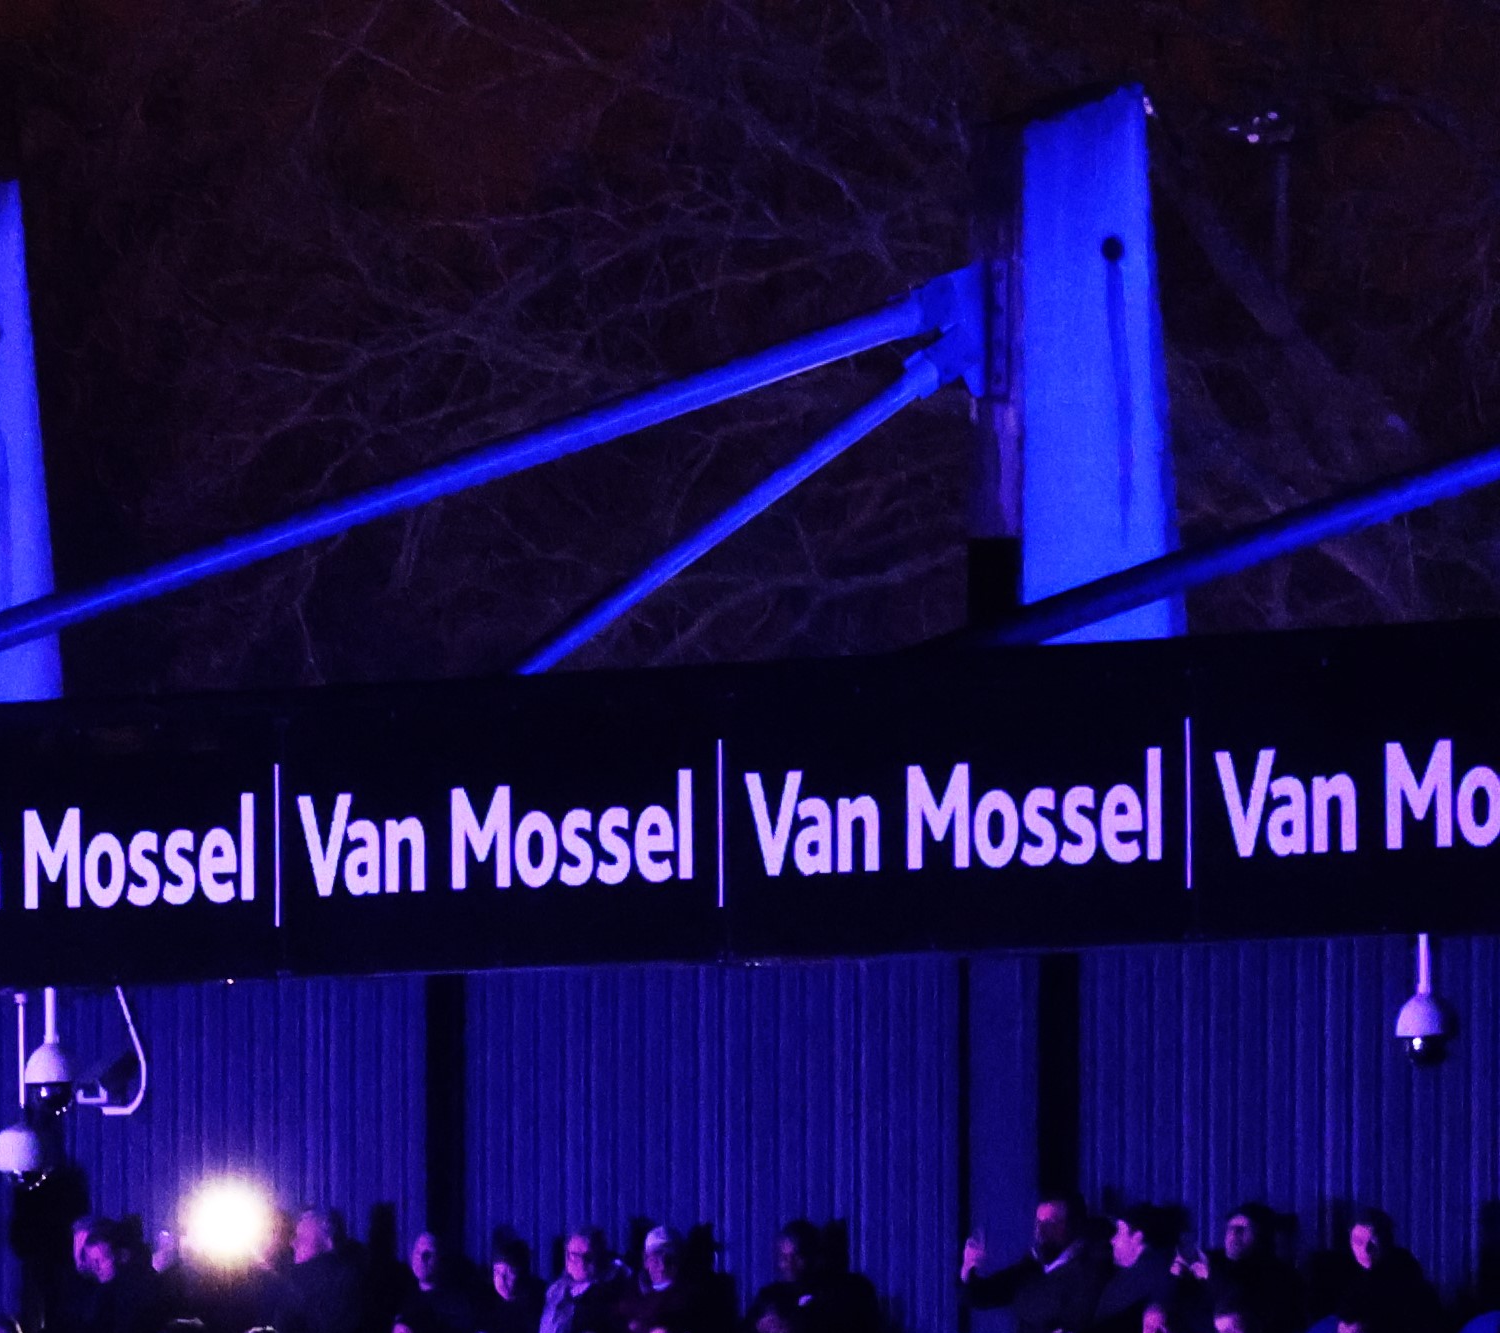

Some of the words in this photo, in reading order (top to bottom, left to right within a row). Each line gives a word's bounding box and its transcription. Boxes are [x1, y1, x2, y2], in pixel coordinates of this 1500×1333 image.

[23, 793, 255, 910] Mossel
[297, 793, 426, 897] Van
[450, 768, 695, 889] Mossel
[745, 770, 880, 877] Van
[906, 747, 1162, 869] Mossel
[1216, 748, 1358, 857] Van
[1385, 739, 1500, 850] Mo
